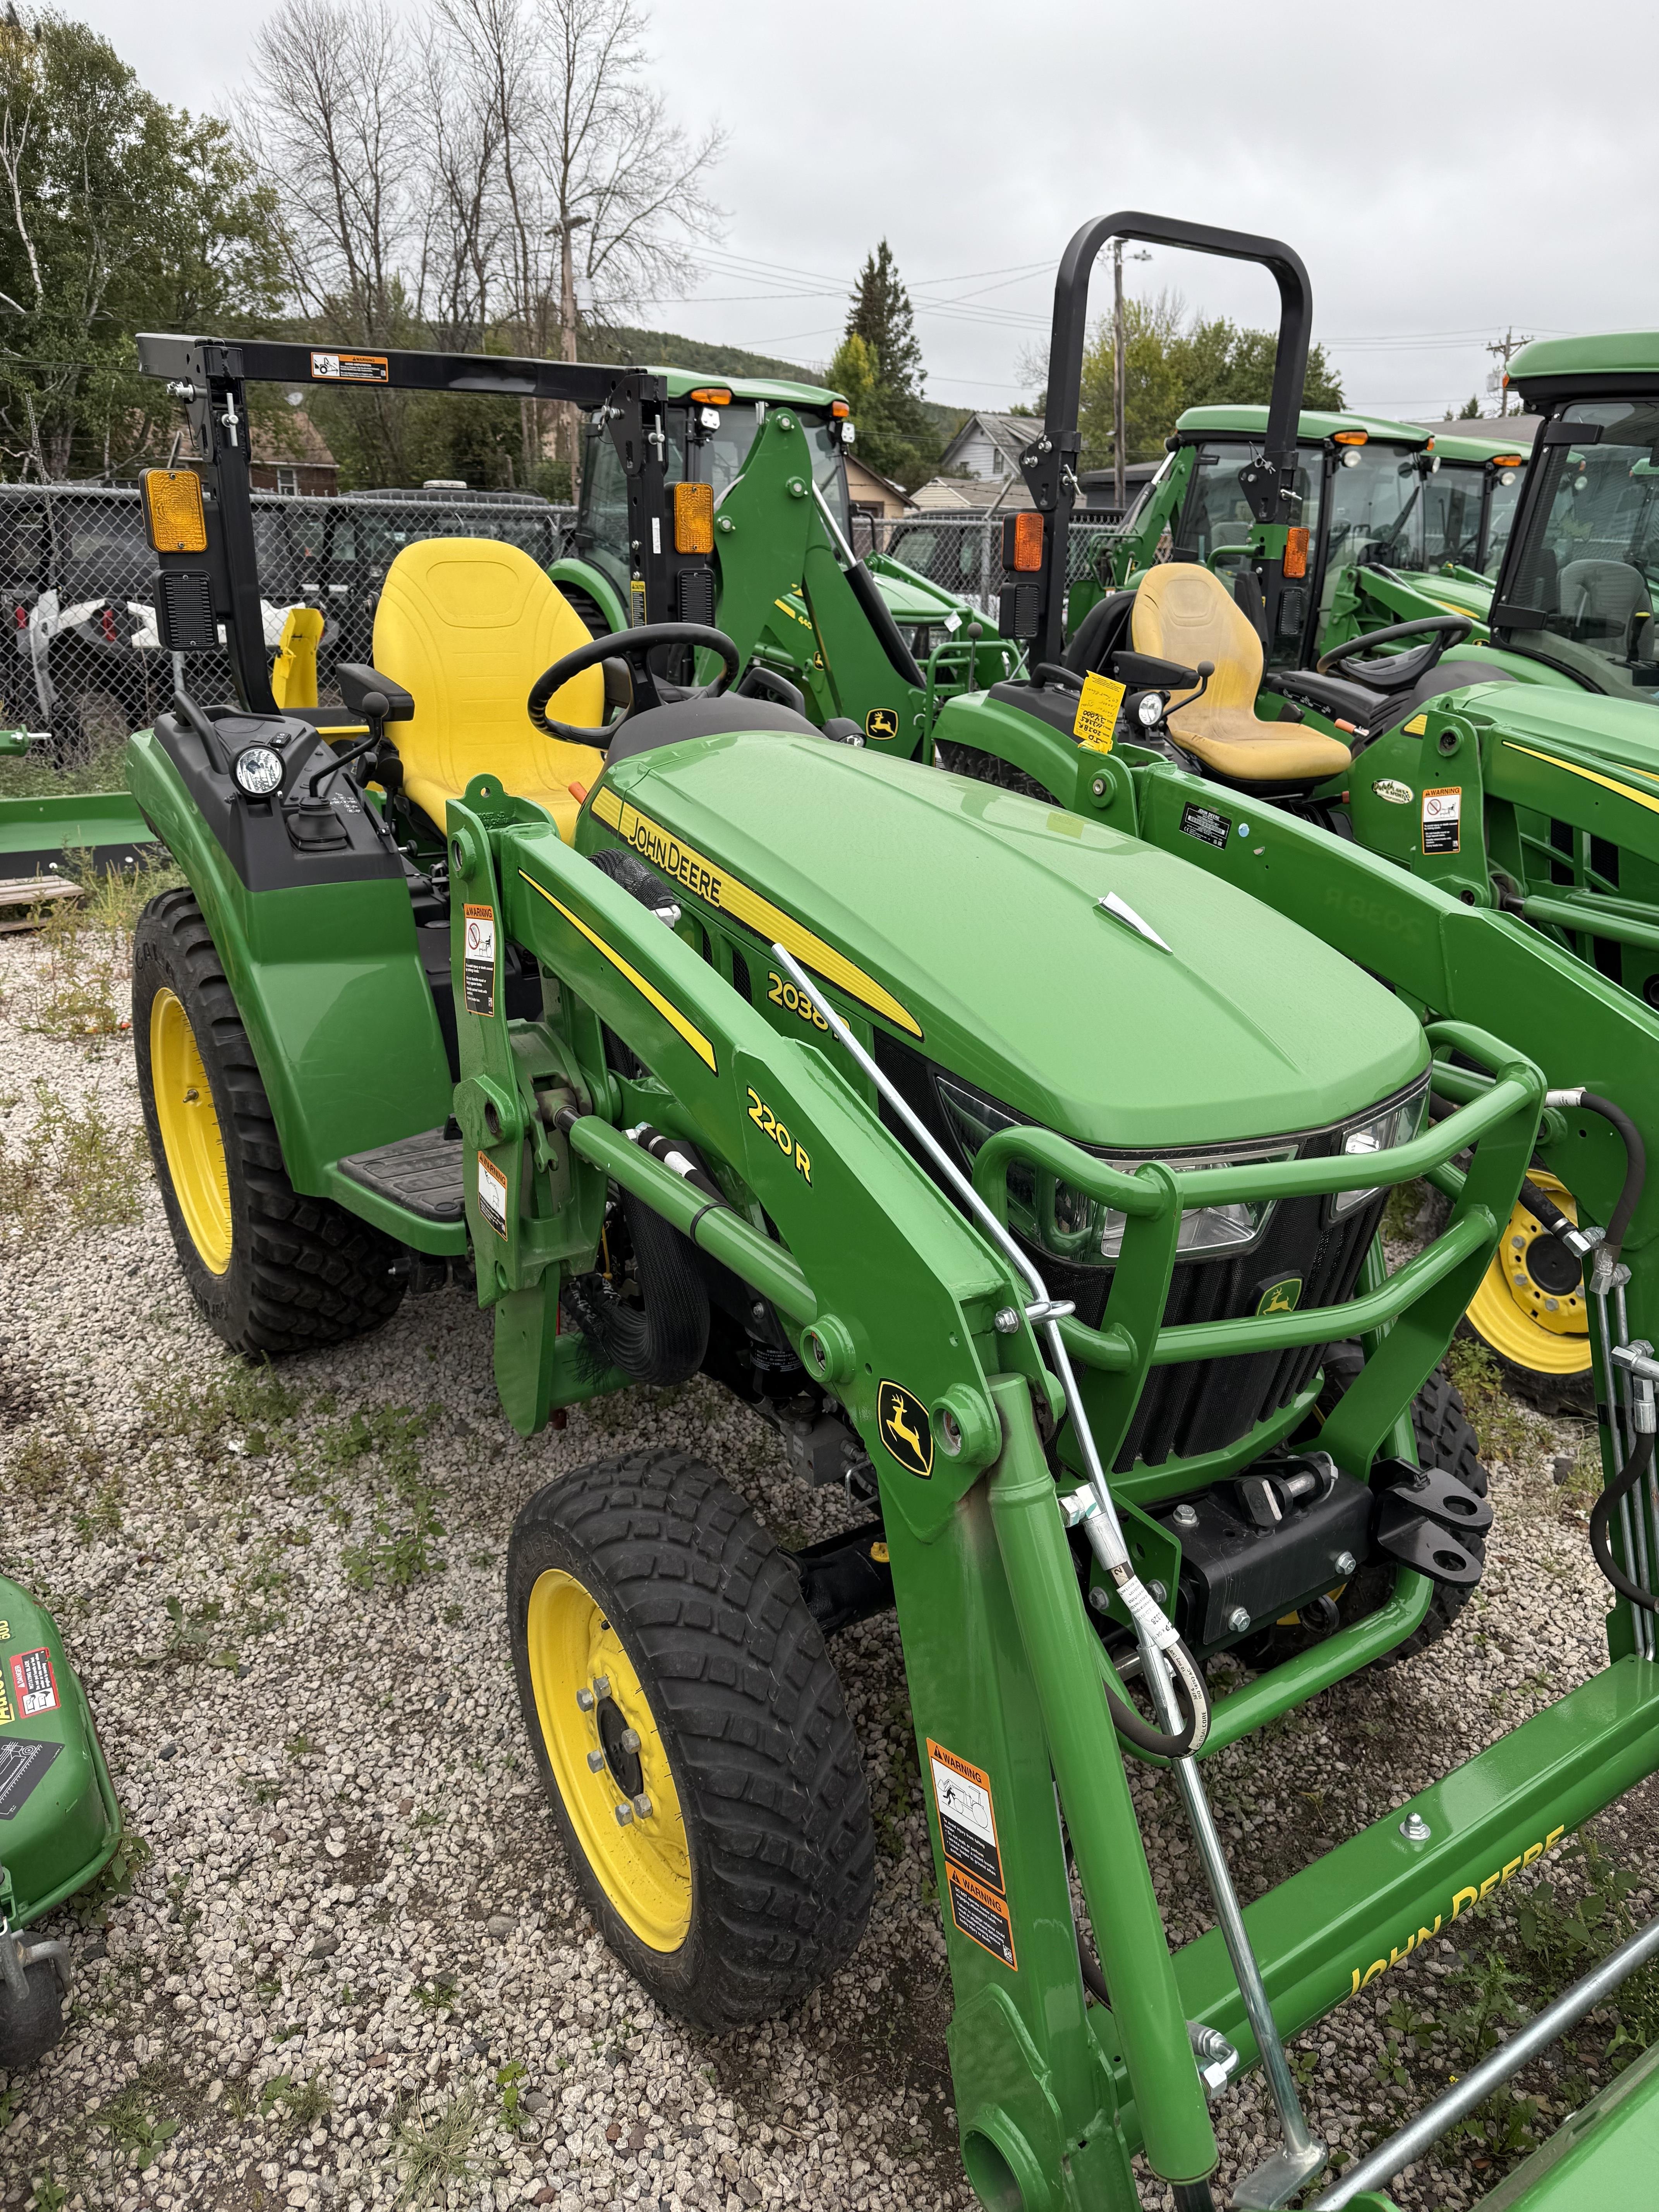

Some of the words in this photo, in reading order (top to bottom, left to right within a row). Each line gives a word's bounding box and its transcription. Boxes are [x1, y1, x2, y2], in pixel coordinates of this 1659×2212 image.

[1431, 787, 1460, 796] WARNING
[628, 817, 666, 867] JOHN
[667, 841, 722, 907] DEERE
[469, 908, 493, 918] WARNING
[483, 1157, 506, 1186] WARNING
[14, 1664, 24, 1684] DANGER
[943, 1752, 982, 1784] WARNING
[962, 1877, 1002, 1912] WARNING
